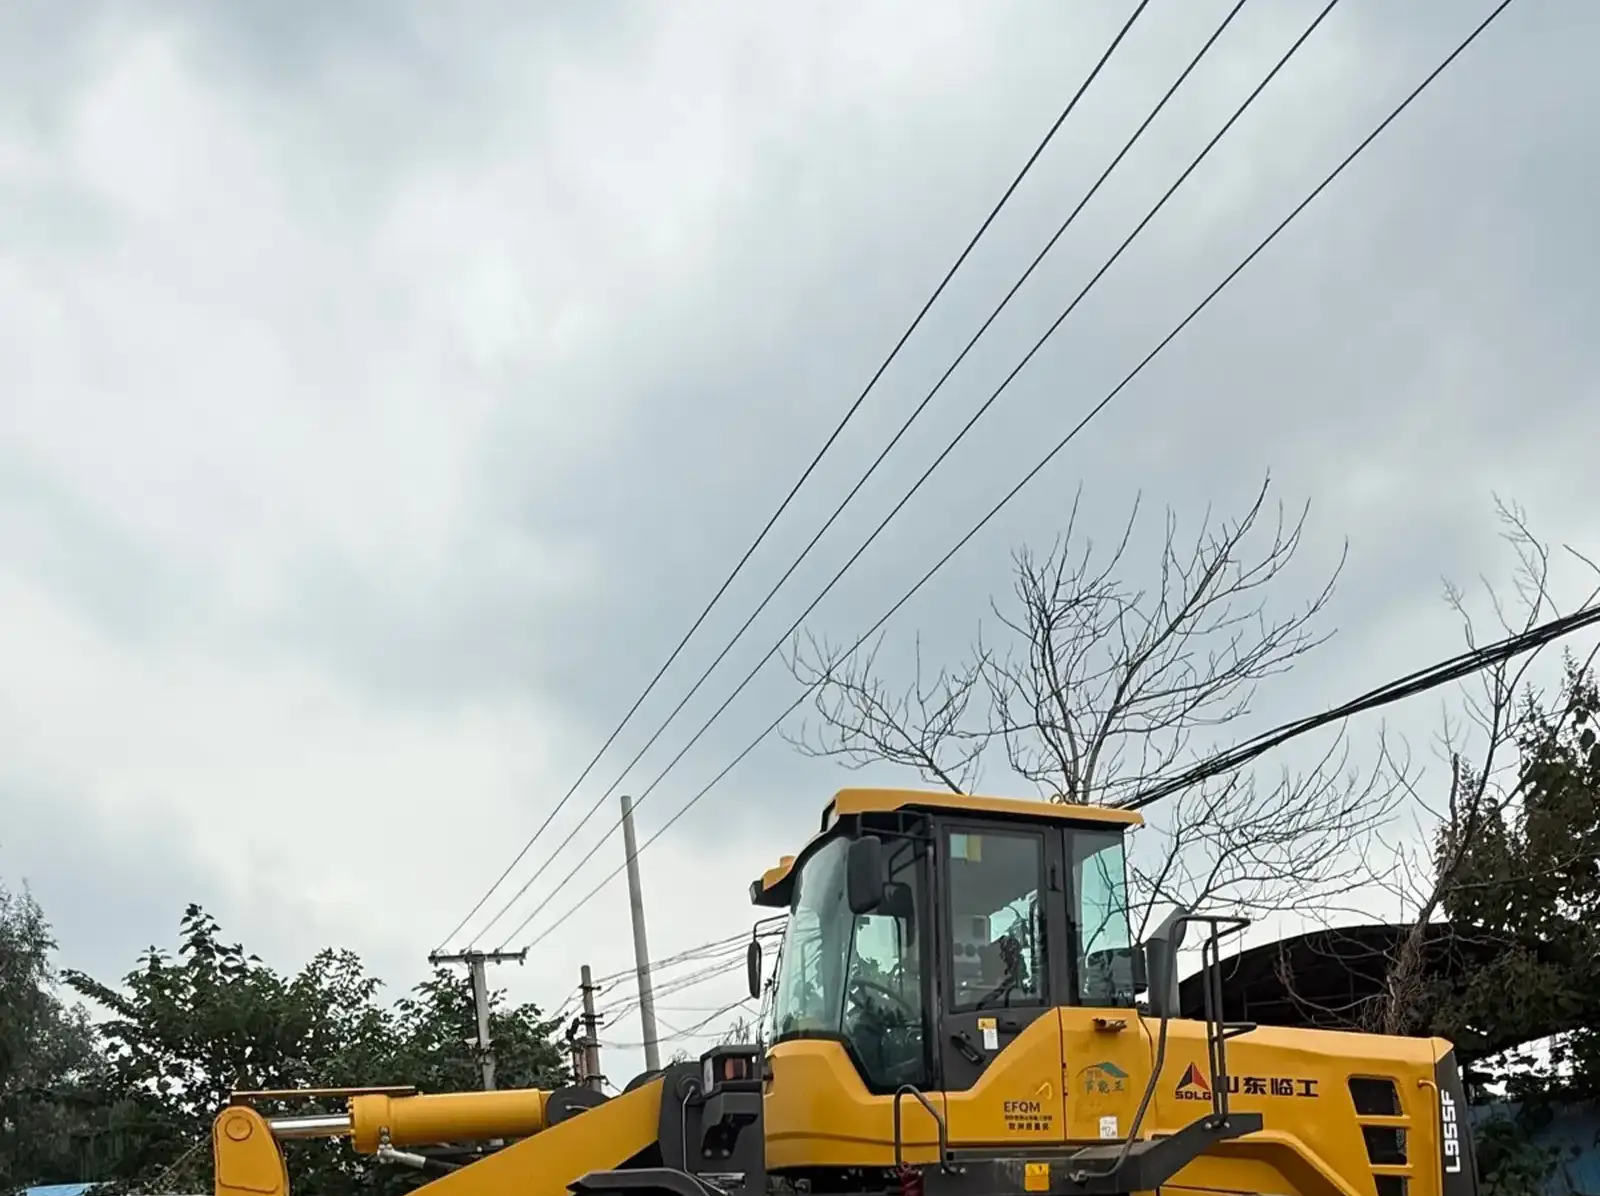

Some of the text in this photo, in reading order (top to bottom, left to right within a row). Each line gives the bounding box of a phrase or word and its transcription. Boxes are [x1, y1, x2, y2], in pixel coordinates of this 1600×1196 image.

[1175, 1090, 1212, 1100] SDLG
[1003, 1101, 1041, 1113] EFQM
[1441, 1089, 1461, 1173] L955F
